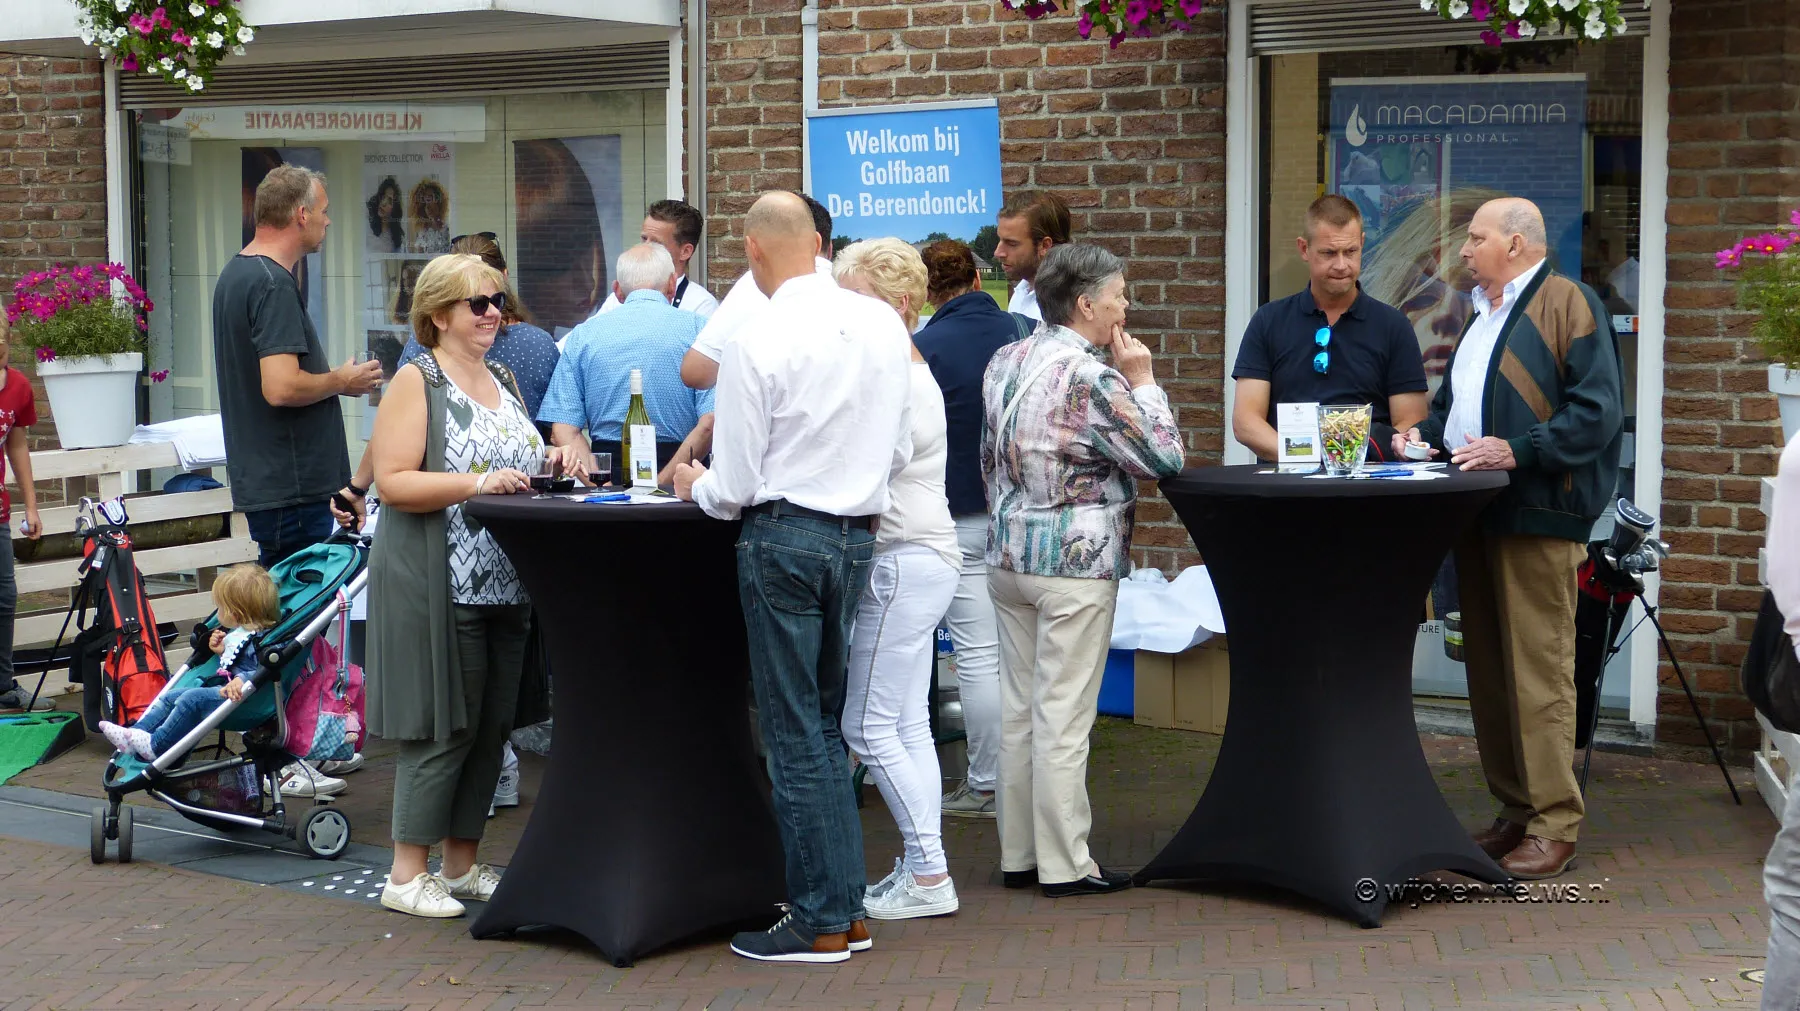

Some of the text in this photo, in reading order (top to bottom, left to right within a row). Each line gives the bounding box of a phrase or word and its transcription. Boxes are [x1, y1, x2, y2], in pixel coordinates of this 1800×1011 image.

[1376, 103, 1566, 125] MACADAMIA
[846, 125, 961, 156] Welkom bij
[1376, 133, 1509, 144] PROFESSIONAL
[388, 153, 423, 163] COLLECTION
[860, 160, 950, 186] Golfbaan
[827, 188, 987, 218] De Berendonck!
[937, 628, 951, 642] Be
